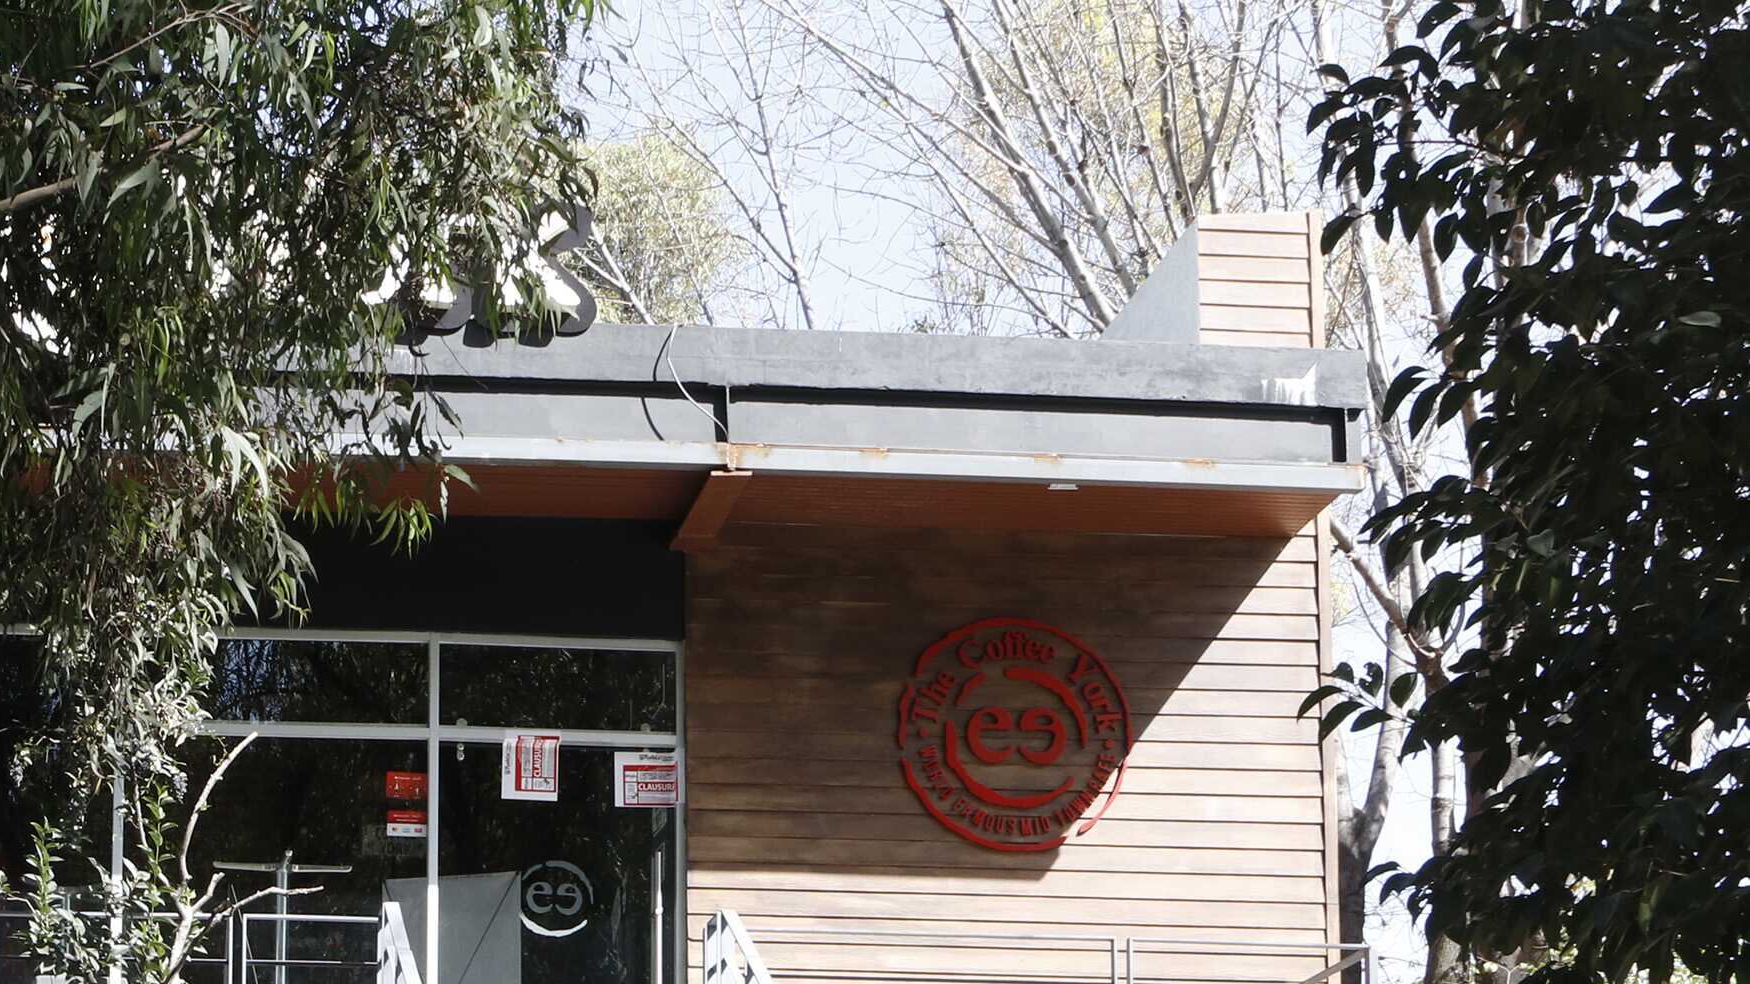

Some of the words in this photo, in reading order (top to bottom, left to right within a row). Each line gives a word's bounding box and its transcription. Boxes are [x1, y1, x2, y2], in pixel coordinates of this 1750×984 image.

[912, 671, 956, 722] The
[959, 631, 1057, 668] Coffee
[1070, 653, 1122, 734] York
